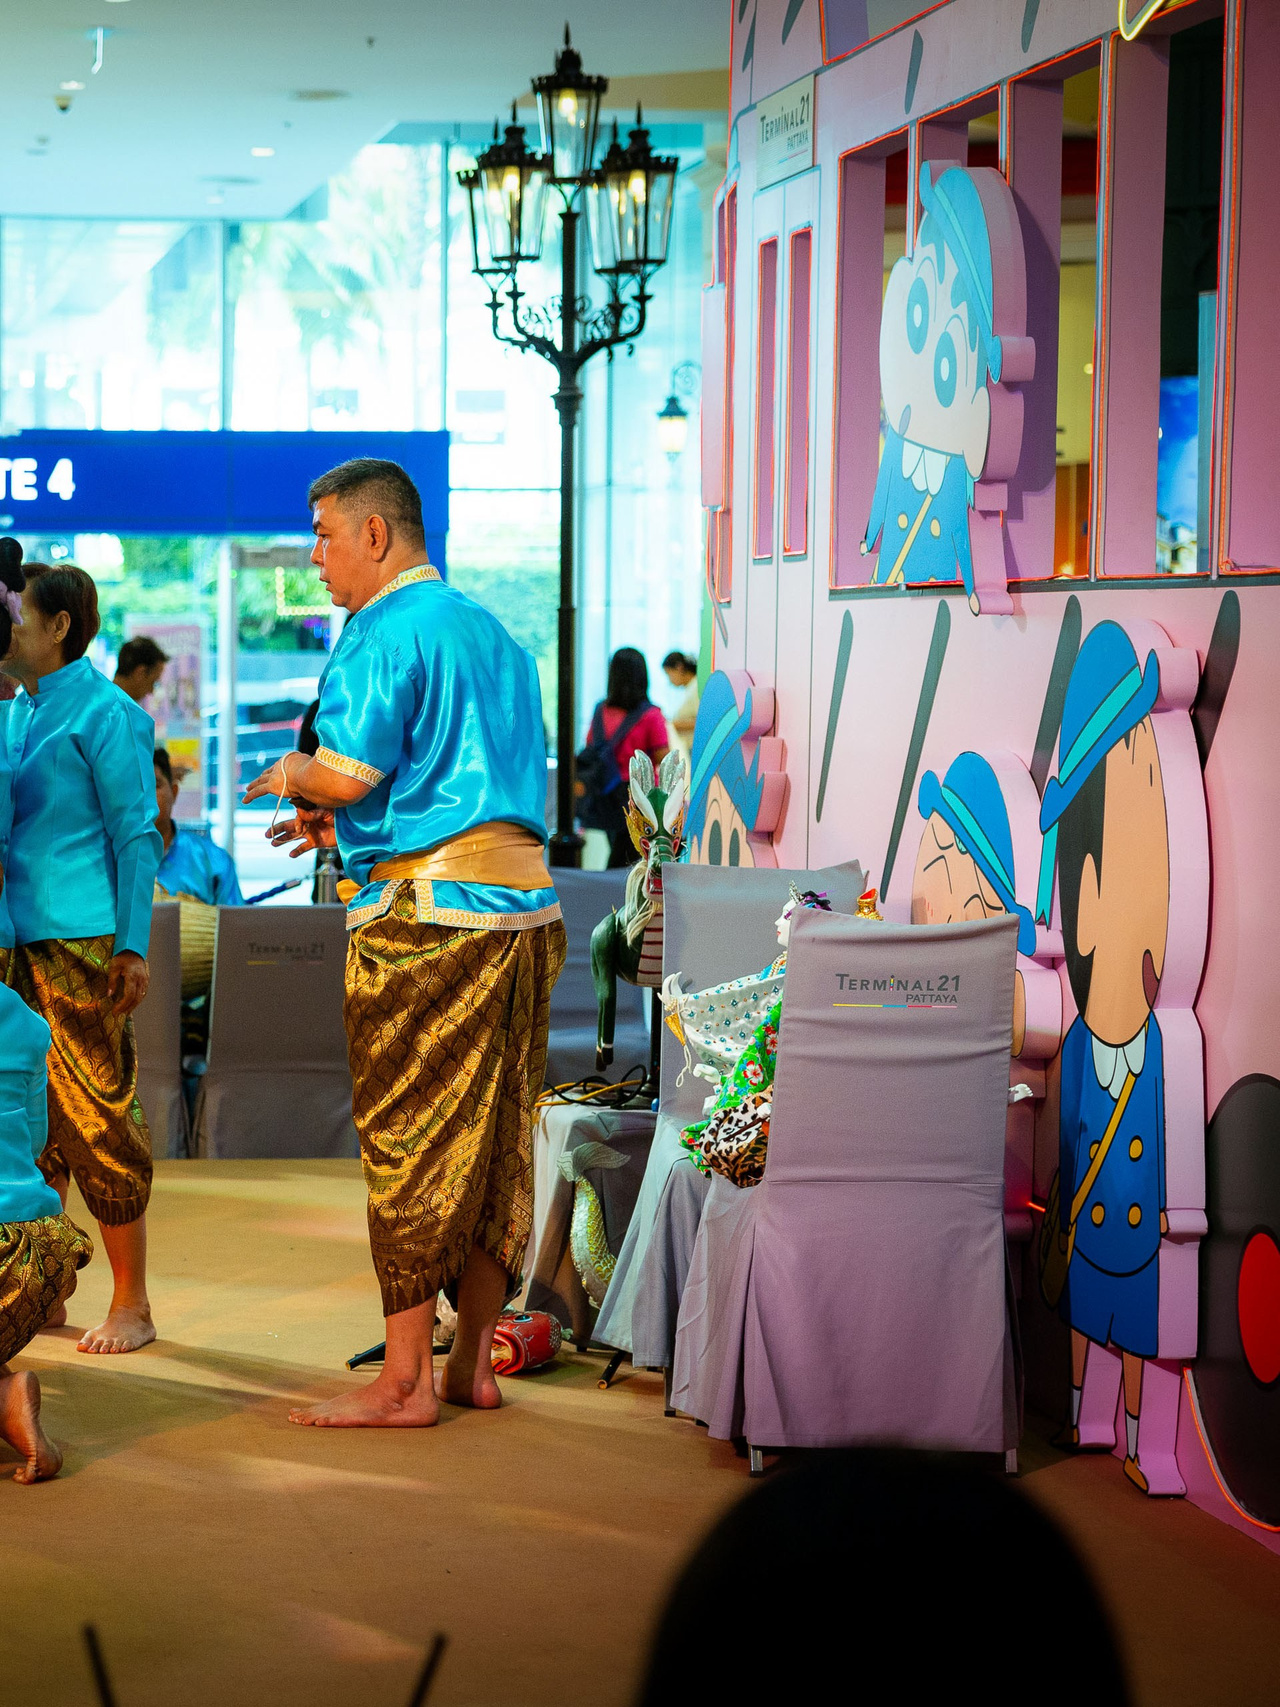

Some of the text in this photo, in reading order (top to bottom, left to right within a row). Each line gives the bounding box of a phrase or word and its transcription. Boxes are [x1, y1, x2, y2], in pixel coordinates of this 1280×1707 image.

[786, 129, 810, 151] PATTAYA
[46, 457, 76, 501] 4
[905, 993, 958, 1004] PATTAYA
